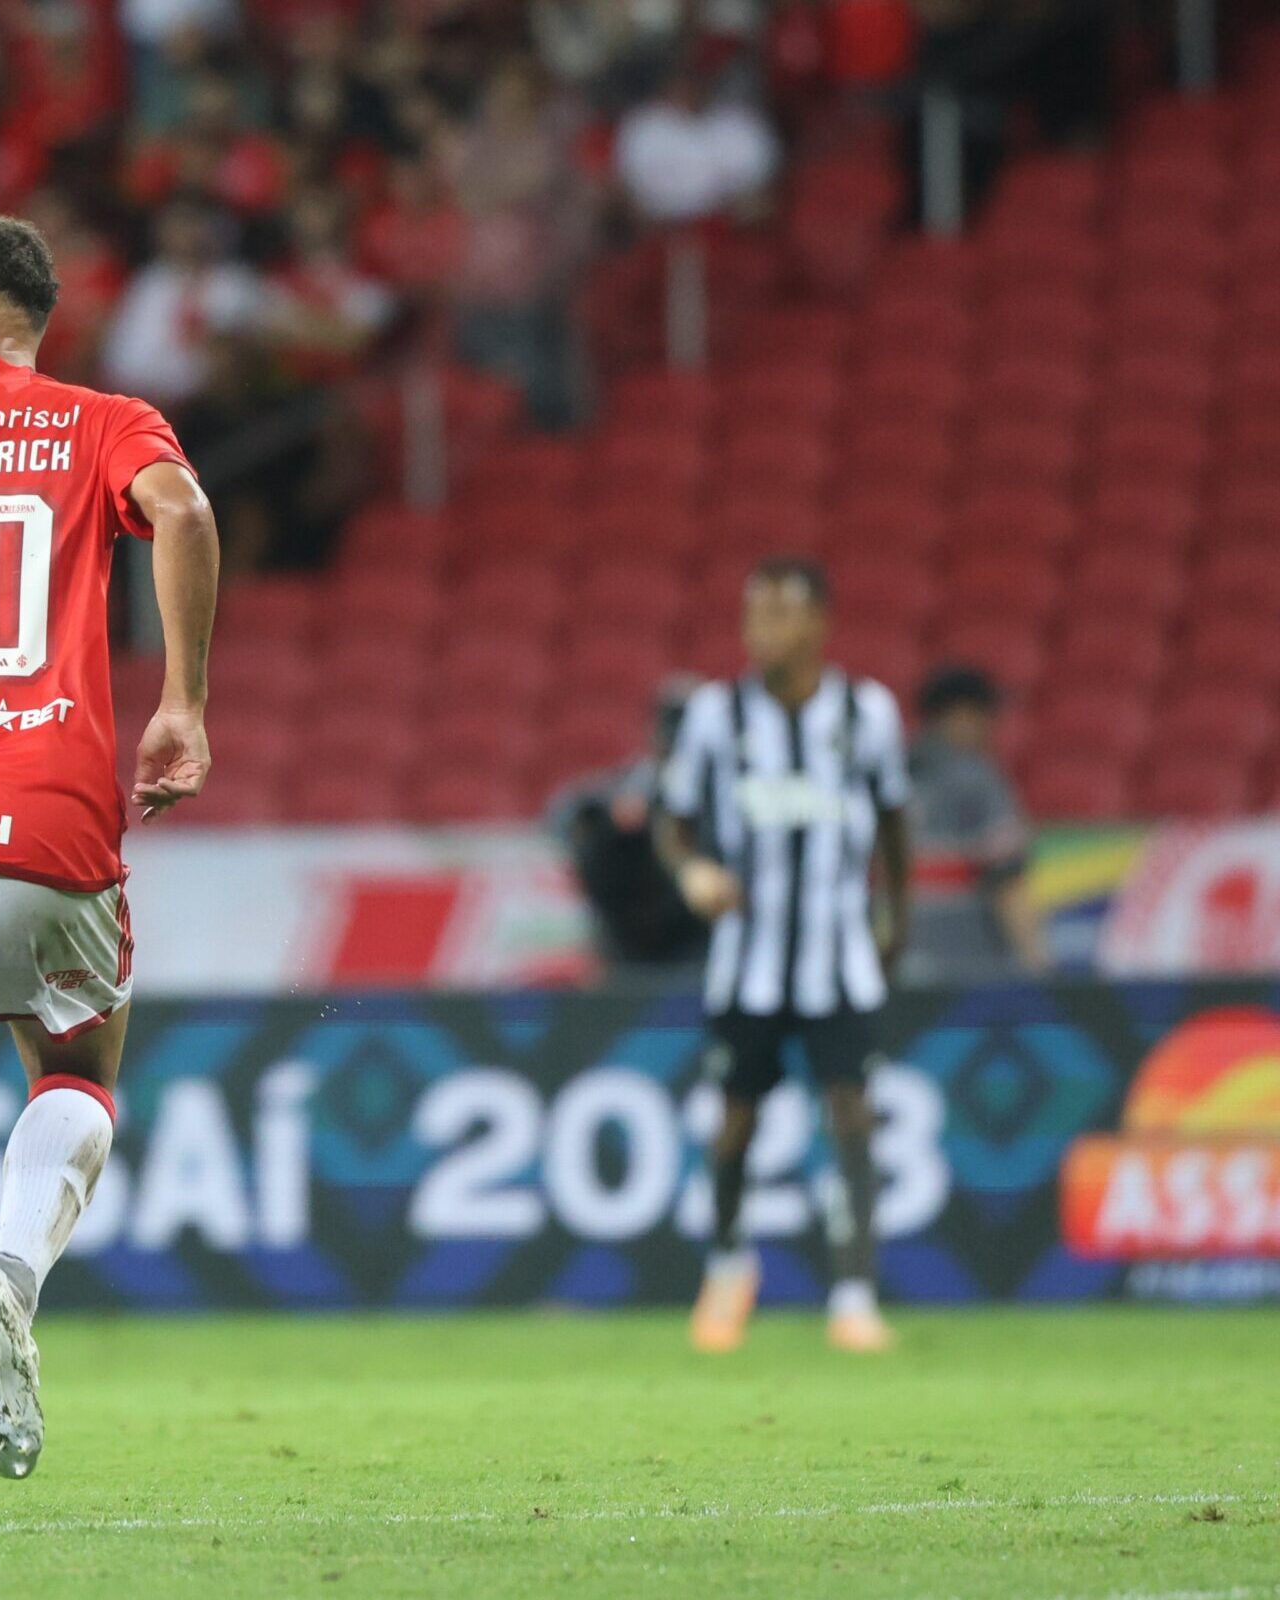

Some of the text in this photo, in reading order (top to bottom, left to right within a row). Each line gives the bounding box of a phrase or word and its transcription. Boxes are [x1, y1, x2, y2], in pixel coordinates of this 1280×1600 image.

[20, 698, 75, 730] BET
[410, 1068, 950, 1242] 2023
[1094, 1148, 1280, 1246] ASS
